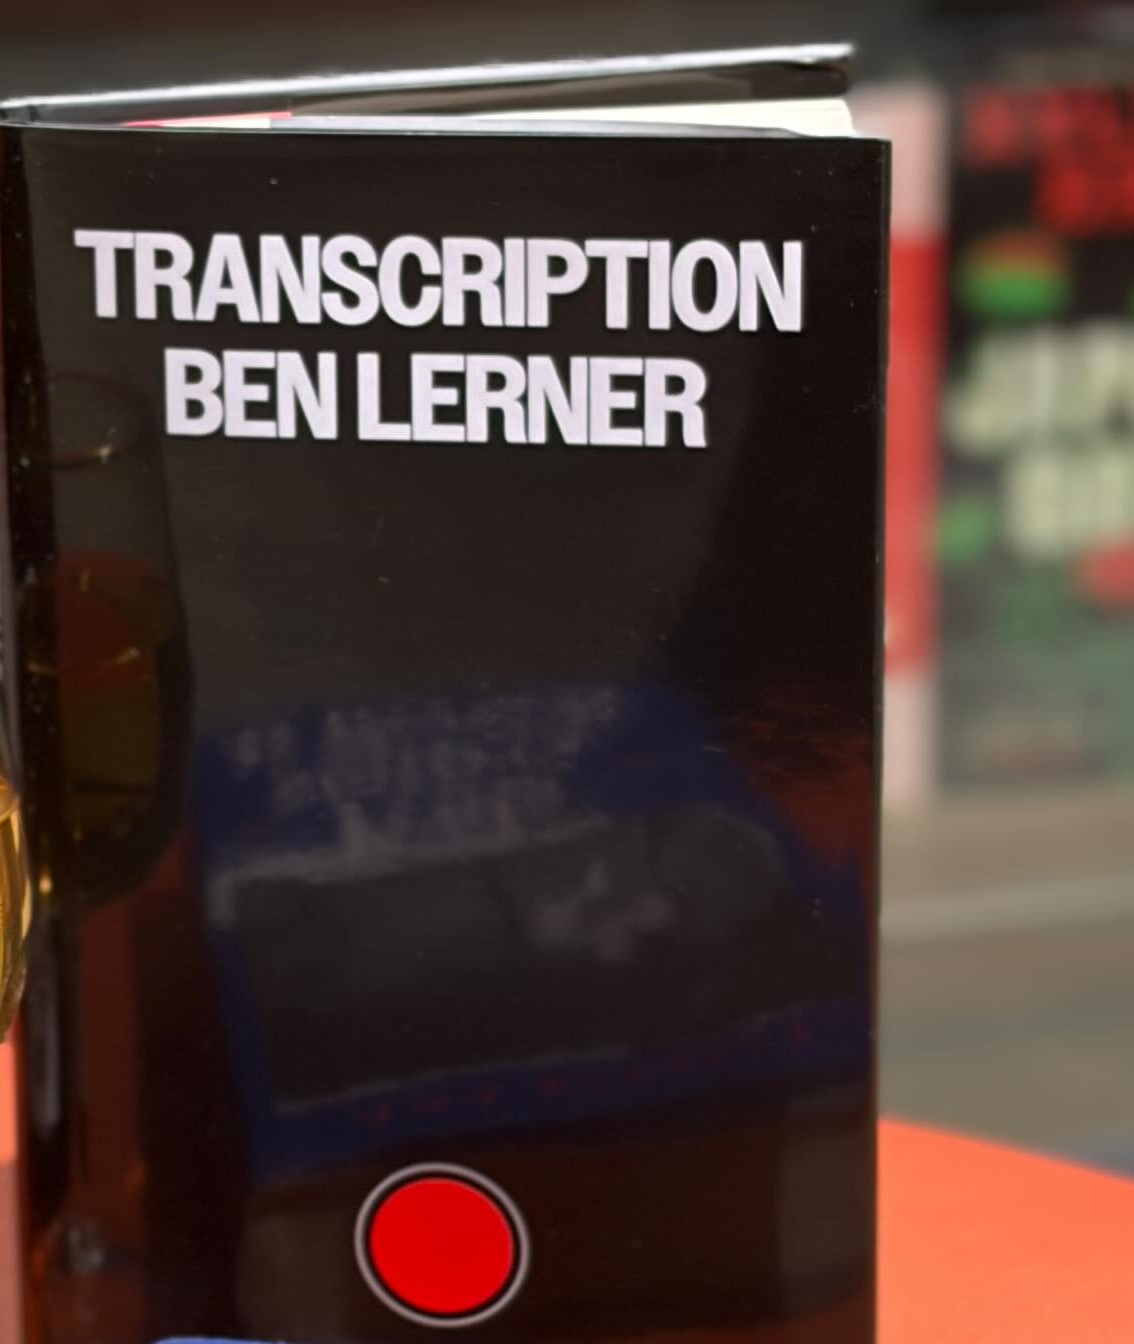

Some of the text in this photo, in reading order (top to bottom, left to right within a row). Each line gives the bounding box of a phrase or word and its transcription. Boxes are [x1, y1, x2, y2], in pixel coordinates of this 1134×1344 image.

[74, 228, 804, 333] TRANSCRIPTION
[164, 346, 708, 448] BEN LERNER
